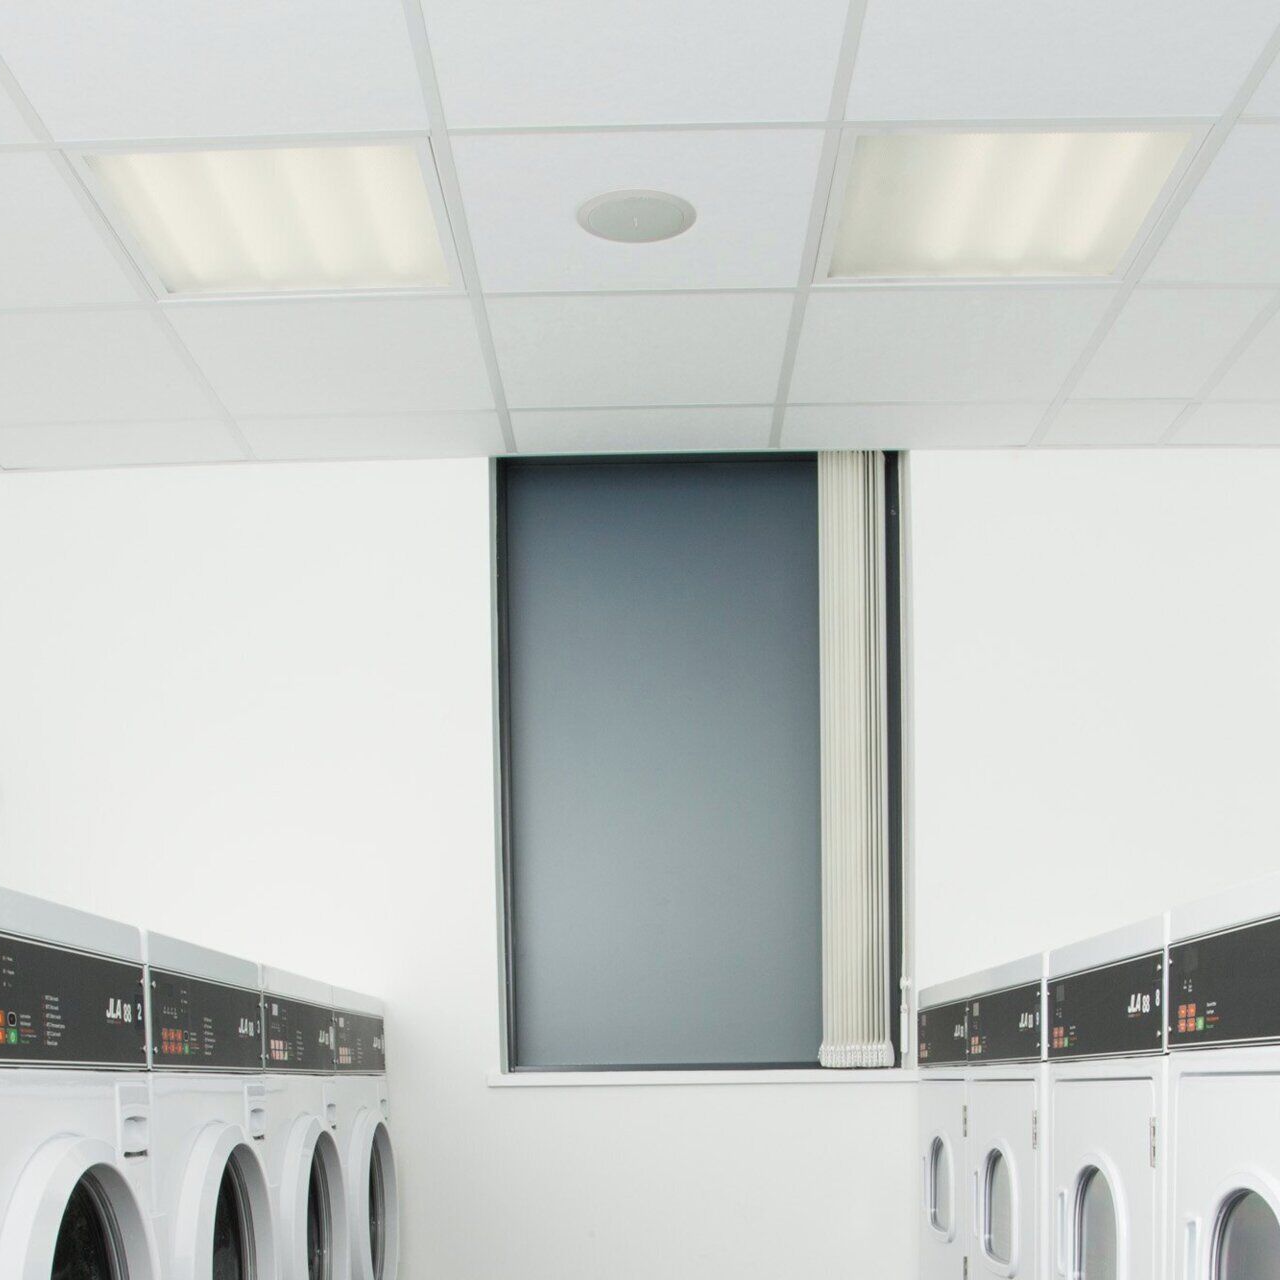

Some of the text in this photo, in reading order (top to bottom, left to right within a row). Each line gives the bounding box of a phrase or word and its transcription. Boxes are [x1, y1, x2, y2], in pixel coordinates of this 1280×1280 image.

[1127, 993, 1150, 1013] JLA 88
[1155, 988, 1160, 1007] 8
[106, 997, 122, 1019] JLA
[123, 1003, 132, 1022] 88
[137, 1003, 142, 1020] 2
